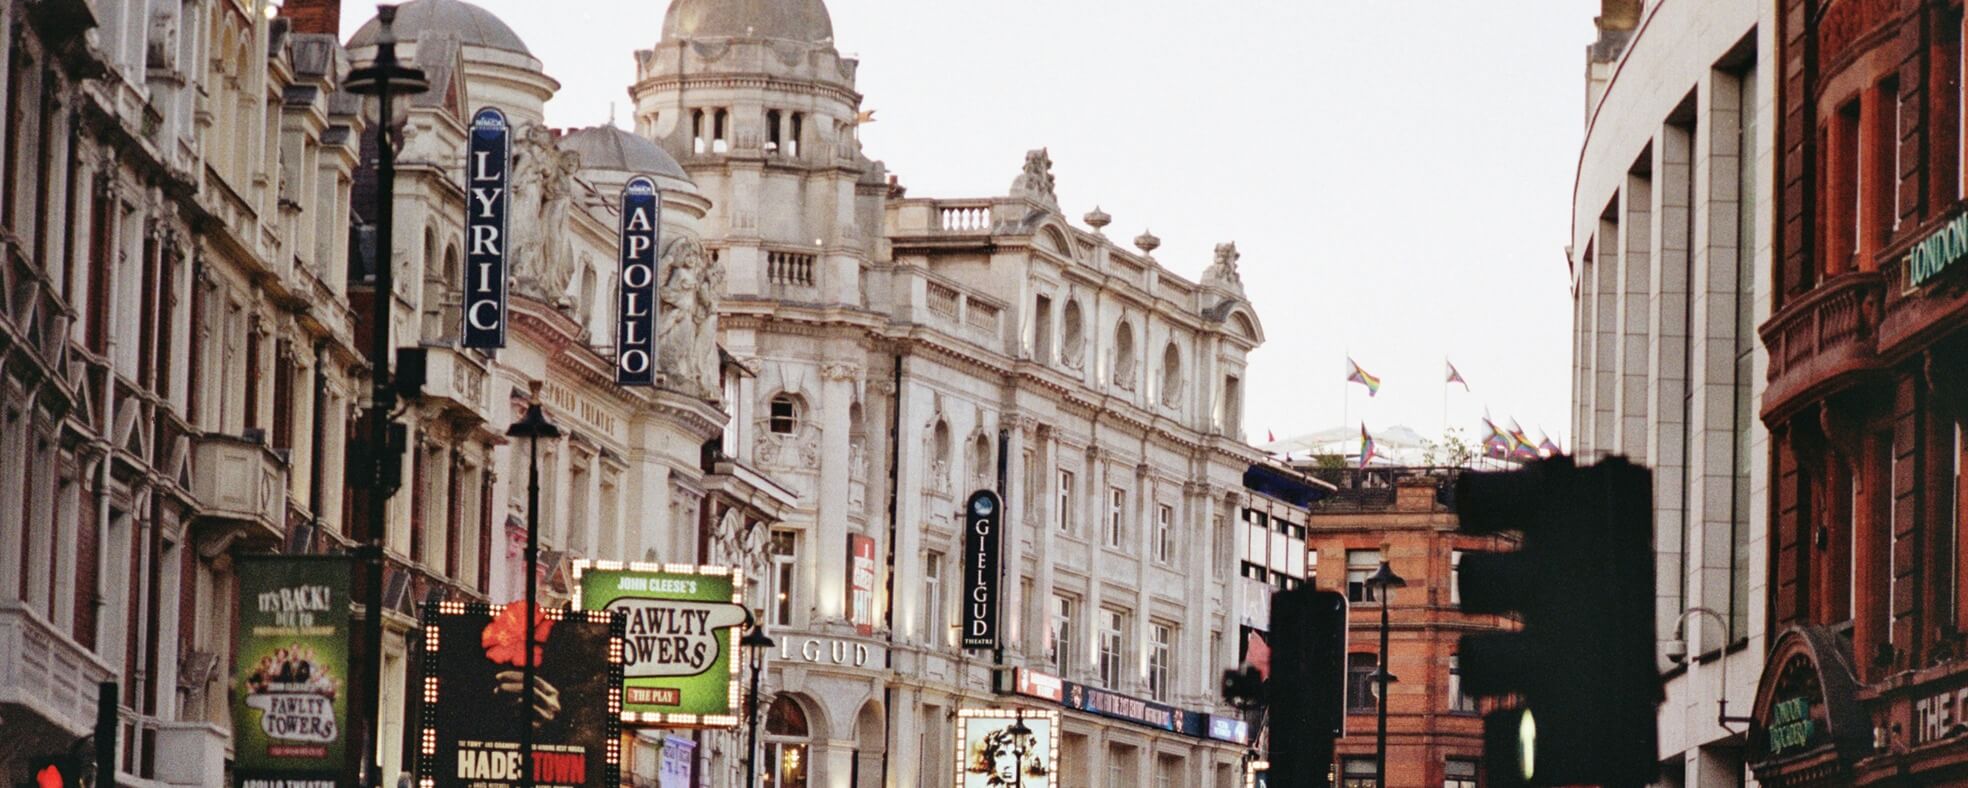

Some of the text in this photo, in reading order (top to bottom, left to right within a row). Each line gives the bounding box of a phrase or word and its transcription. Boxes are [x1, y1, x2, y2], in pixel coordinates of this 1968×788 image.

[469, 151, 502, 331] LYRIC
[1910, 212, 1968, 287] LONDON
[621, 207, 652, 374] APOLLO
[618, 577, 697, 593] JOHN CLEESE'S
[973, 519, 990, 637] GIELGUD
[280, 584, 331, 613] BACK!
[625, 636, 706, 669] OWERS
[271, 697, 324, 714] FAWLTY
[633, 690, 673, 702] THE PLAY
[267, 714, 333, 738] TOWERS
[1916, 692, 1950, 742] THE
[531, 751, 585, 784] TOWN
